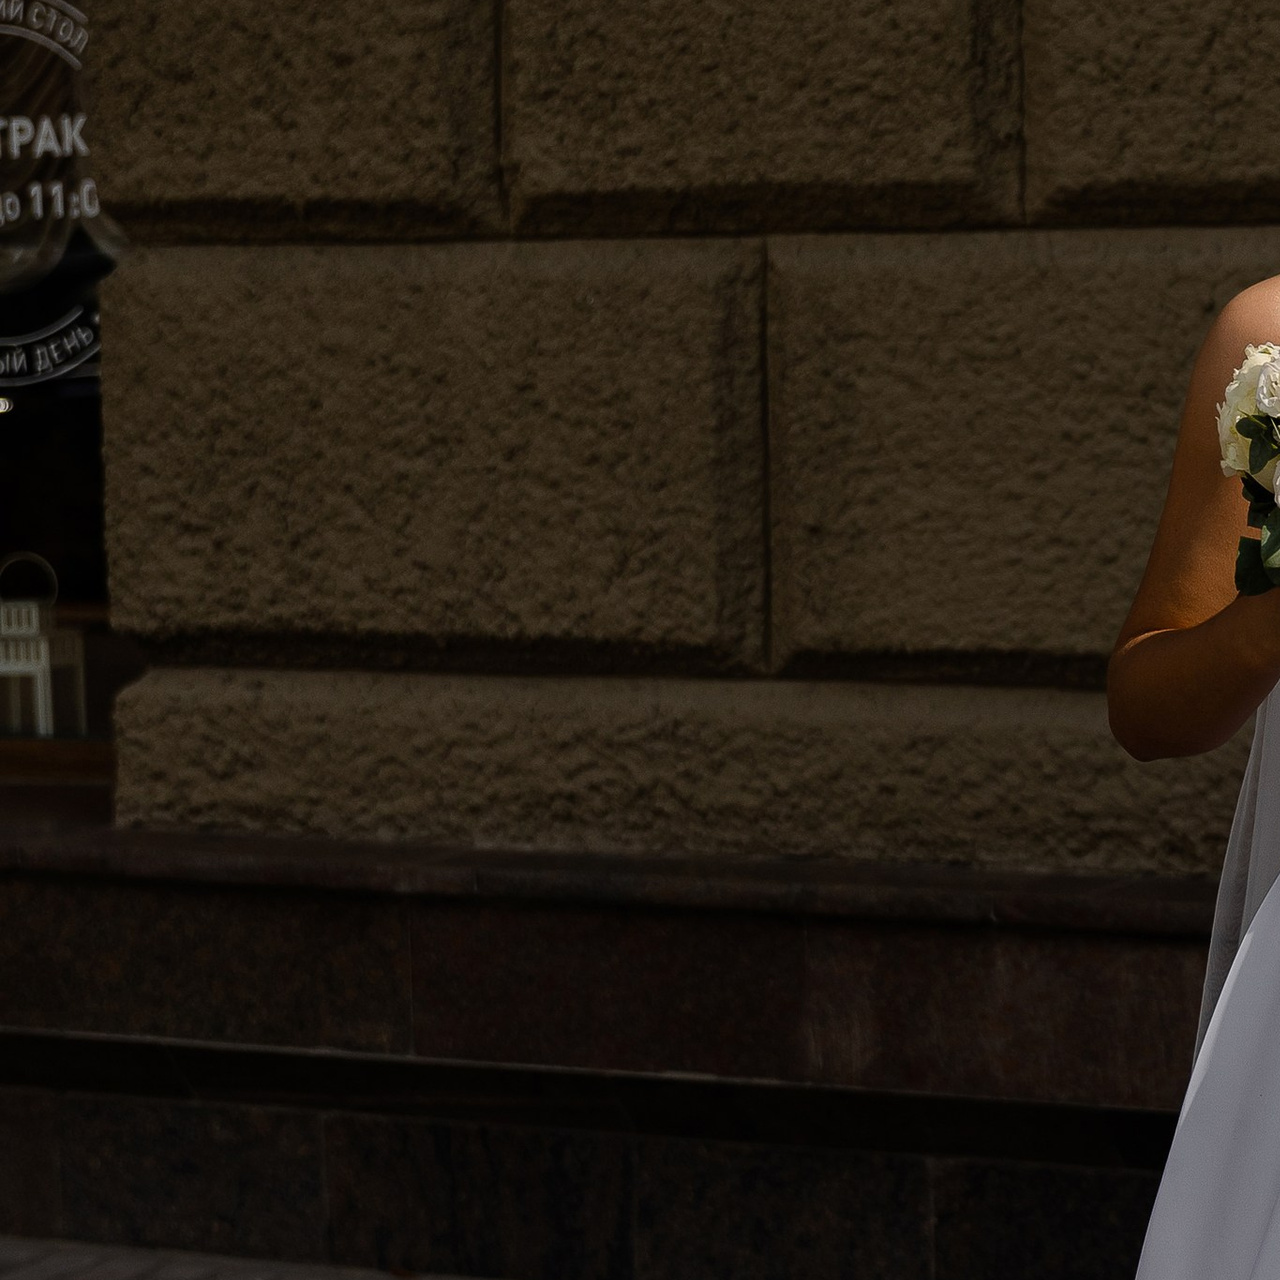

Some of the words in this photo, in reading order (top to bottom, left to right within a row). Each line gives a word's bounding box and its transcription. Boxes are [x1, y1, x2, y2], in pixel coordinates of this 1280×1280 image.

[26, 1, 89, 55] СТОЛ
[0, 190, 21, 224] о
[32, 325, 94, 376] ДЕНЬ
